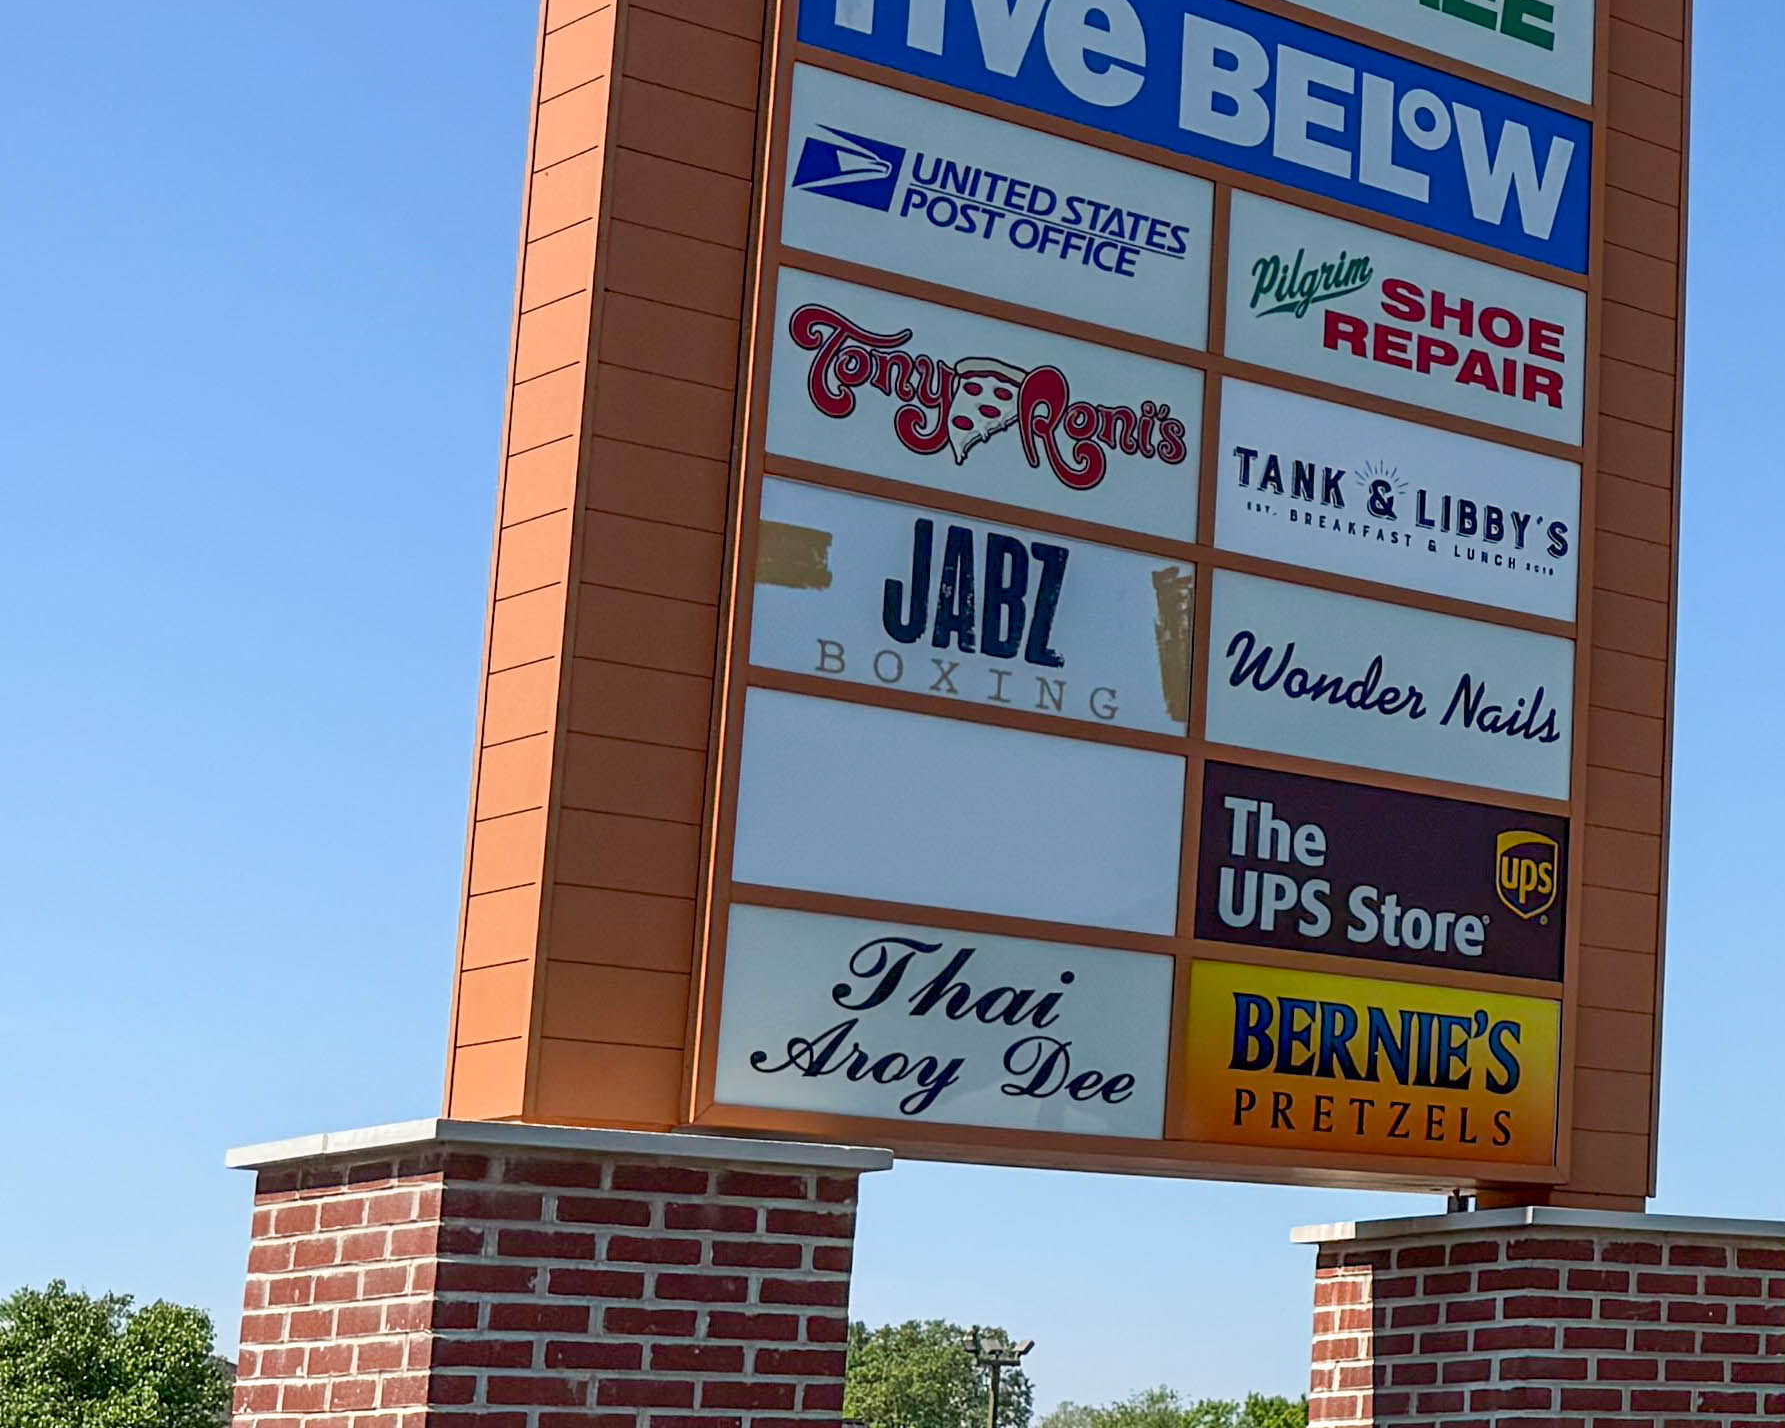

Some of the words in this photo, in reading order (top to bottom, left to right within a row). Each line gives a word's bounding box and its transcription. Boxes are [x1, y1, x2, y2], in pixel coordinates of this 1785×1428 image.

[900, 191, 995, 239] POST
[1009, 221, 1140, 277] OFFICE
[911, 152, 1057, 216] UNITED
[1061, 196, 1189, 254] STATES
[1250, 248, 1373, 318] Pilgrim
[1381, 277, 1565, 363] SHOE
[789, 304, 958, 454] Tony
[1018, 365, 1186, 490] Roni's
[1323, 310, 1564, 409] REPAIR
[1234, 446, 1346, 509] TANK
[1367, 479, 1398, 521] &
[1415, 489, 1569, 559] LIBBY'S
[1290, 509, 1412, 548] BREAKFAST
[1428, 539, 1437, 553] &
[1454, 544, 1517, 570] LUNCH
[883, 518, 1069, 668] JABZ
[815, 638, 1118, 721] BOXING
[1226, 630, 1426, 719] Wonder
[1440, 673, 1560, 743] Nails
[1224, 796, 1326, 866] The
[1218, 867, 1332, 937] UPS
[1501, 855, 1552, 904] ups
[832, 937, 1075, 1029] Thai
[750, 1018, 966, 1115] Aroy
[1000, 1036, 1135, 1104] Dee
[1228, 992, 1521, 1094] BERNIE'S
[1233, 1088, 1512, 1147] PRETZELS
